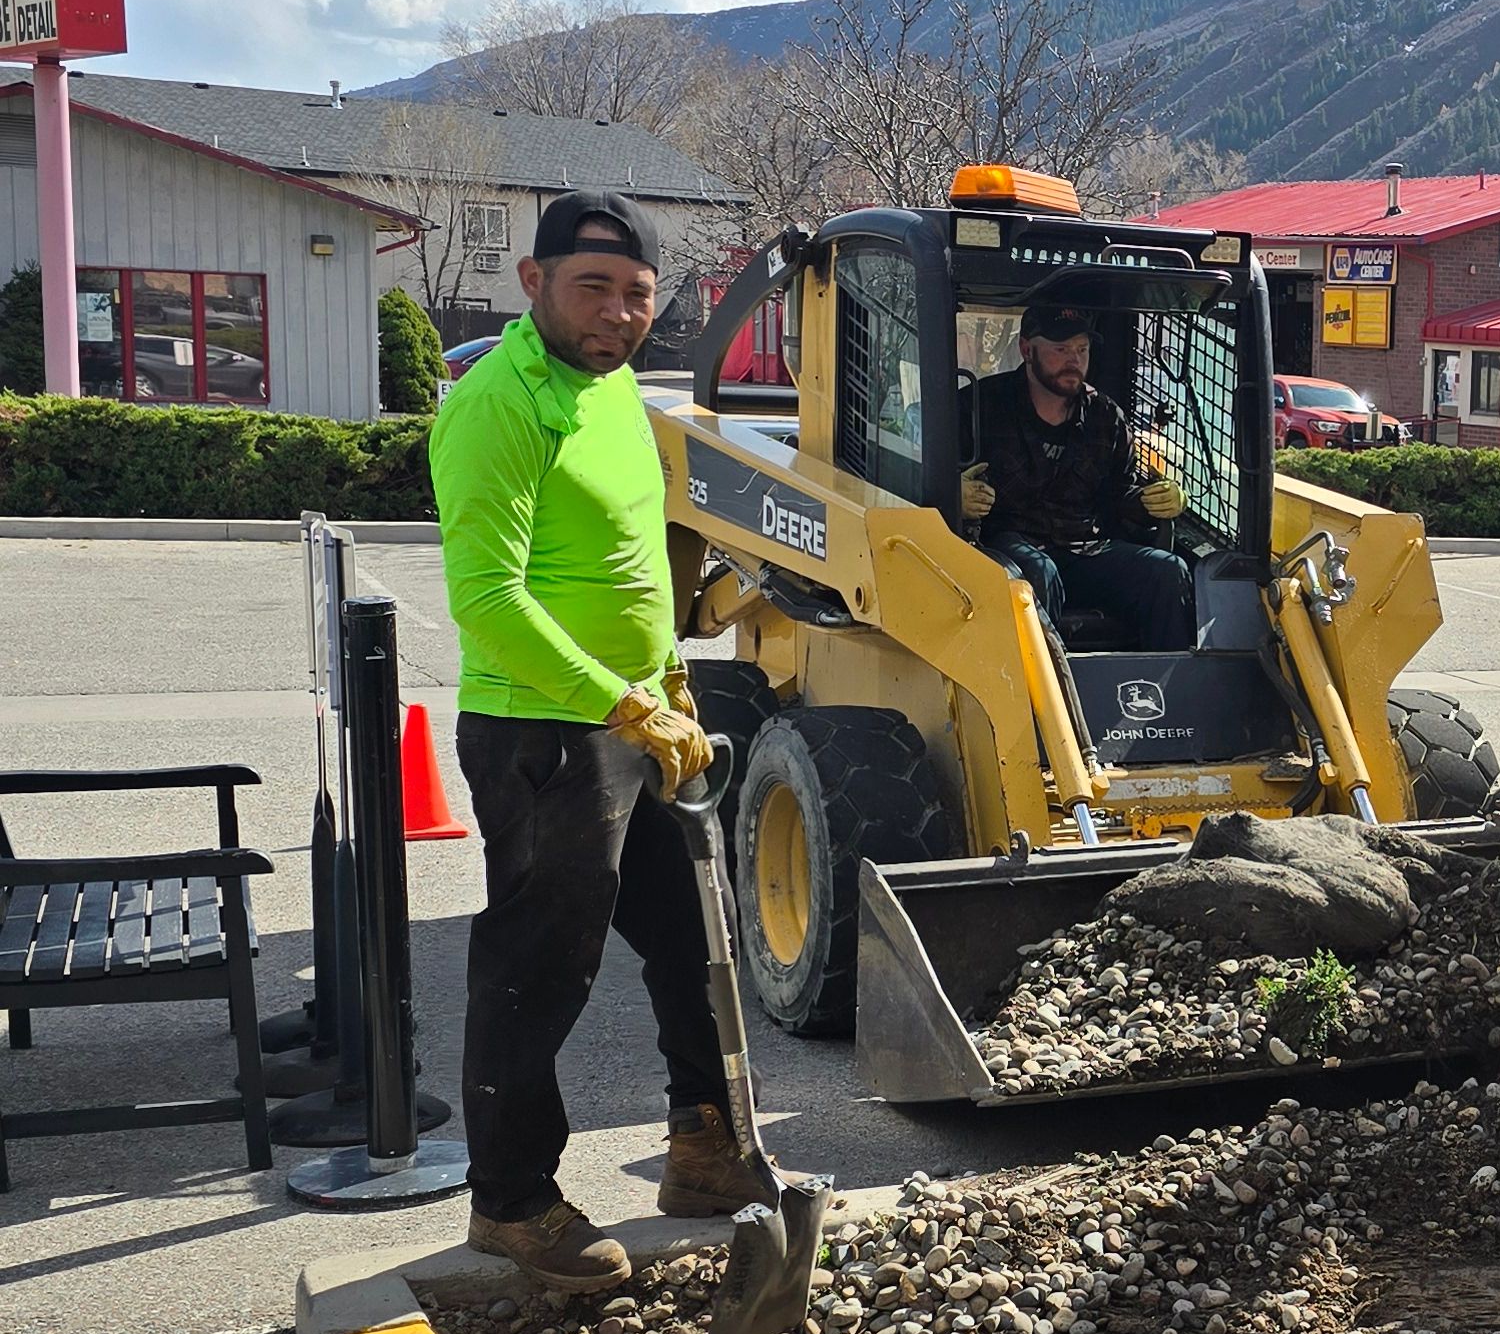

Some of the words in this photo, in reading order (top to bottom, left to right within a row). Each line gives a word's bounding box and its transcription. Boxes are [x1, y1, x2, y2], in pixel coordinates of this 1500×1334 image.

[17, 0, 56, 43] DETAIL
[1266, 251, 1298, 265] Center
[687, 476, 708, 505] 325
[761, 494, 826, 558] DEERE
[1102, 728, 1144, 741] JOHN
[1145, 727, 1195, 739] DEERE
